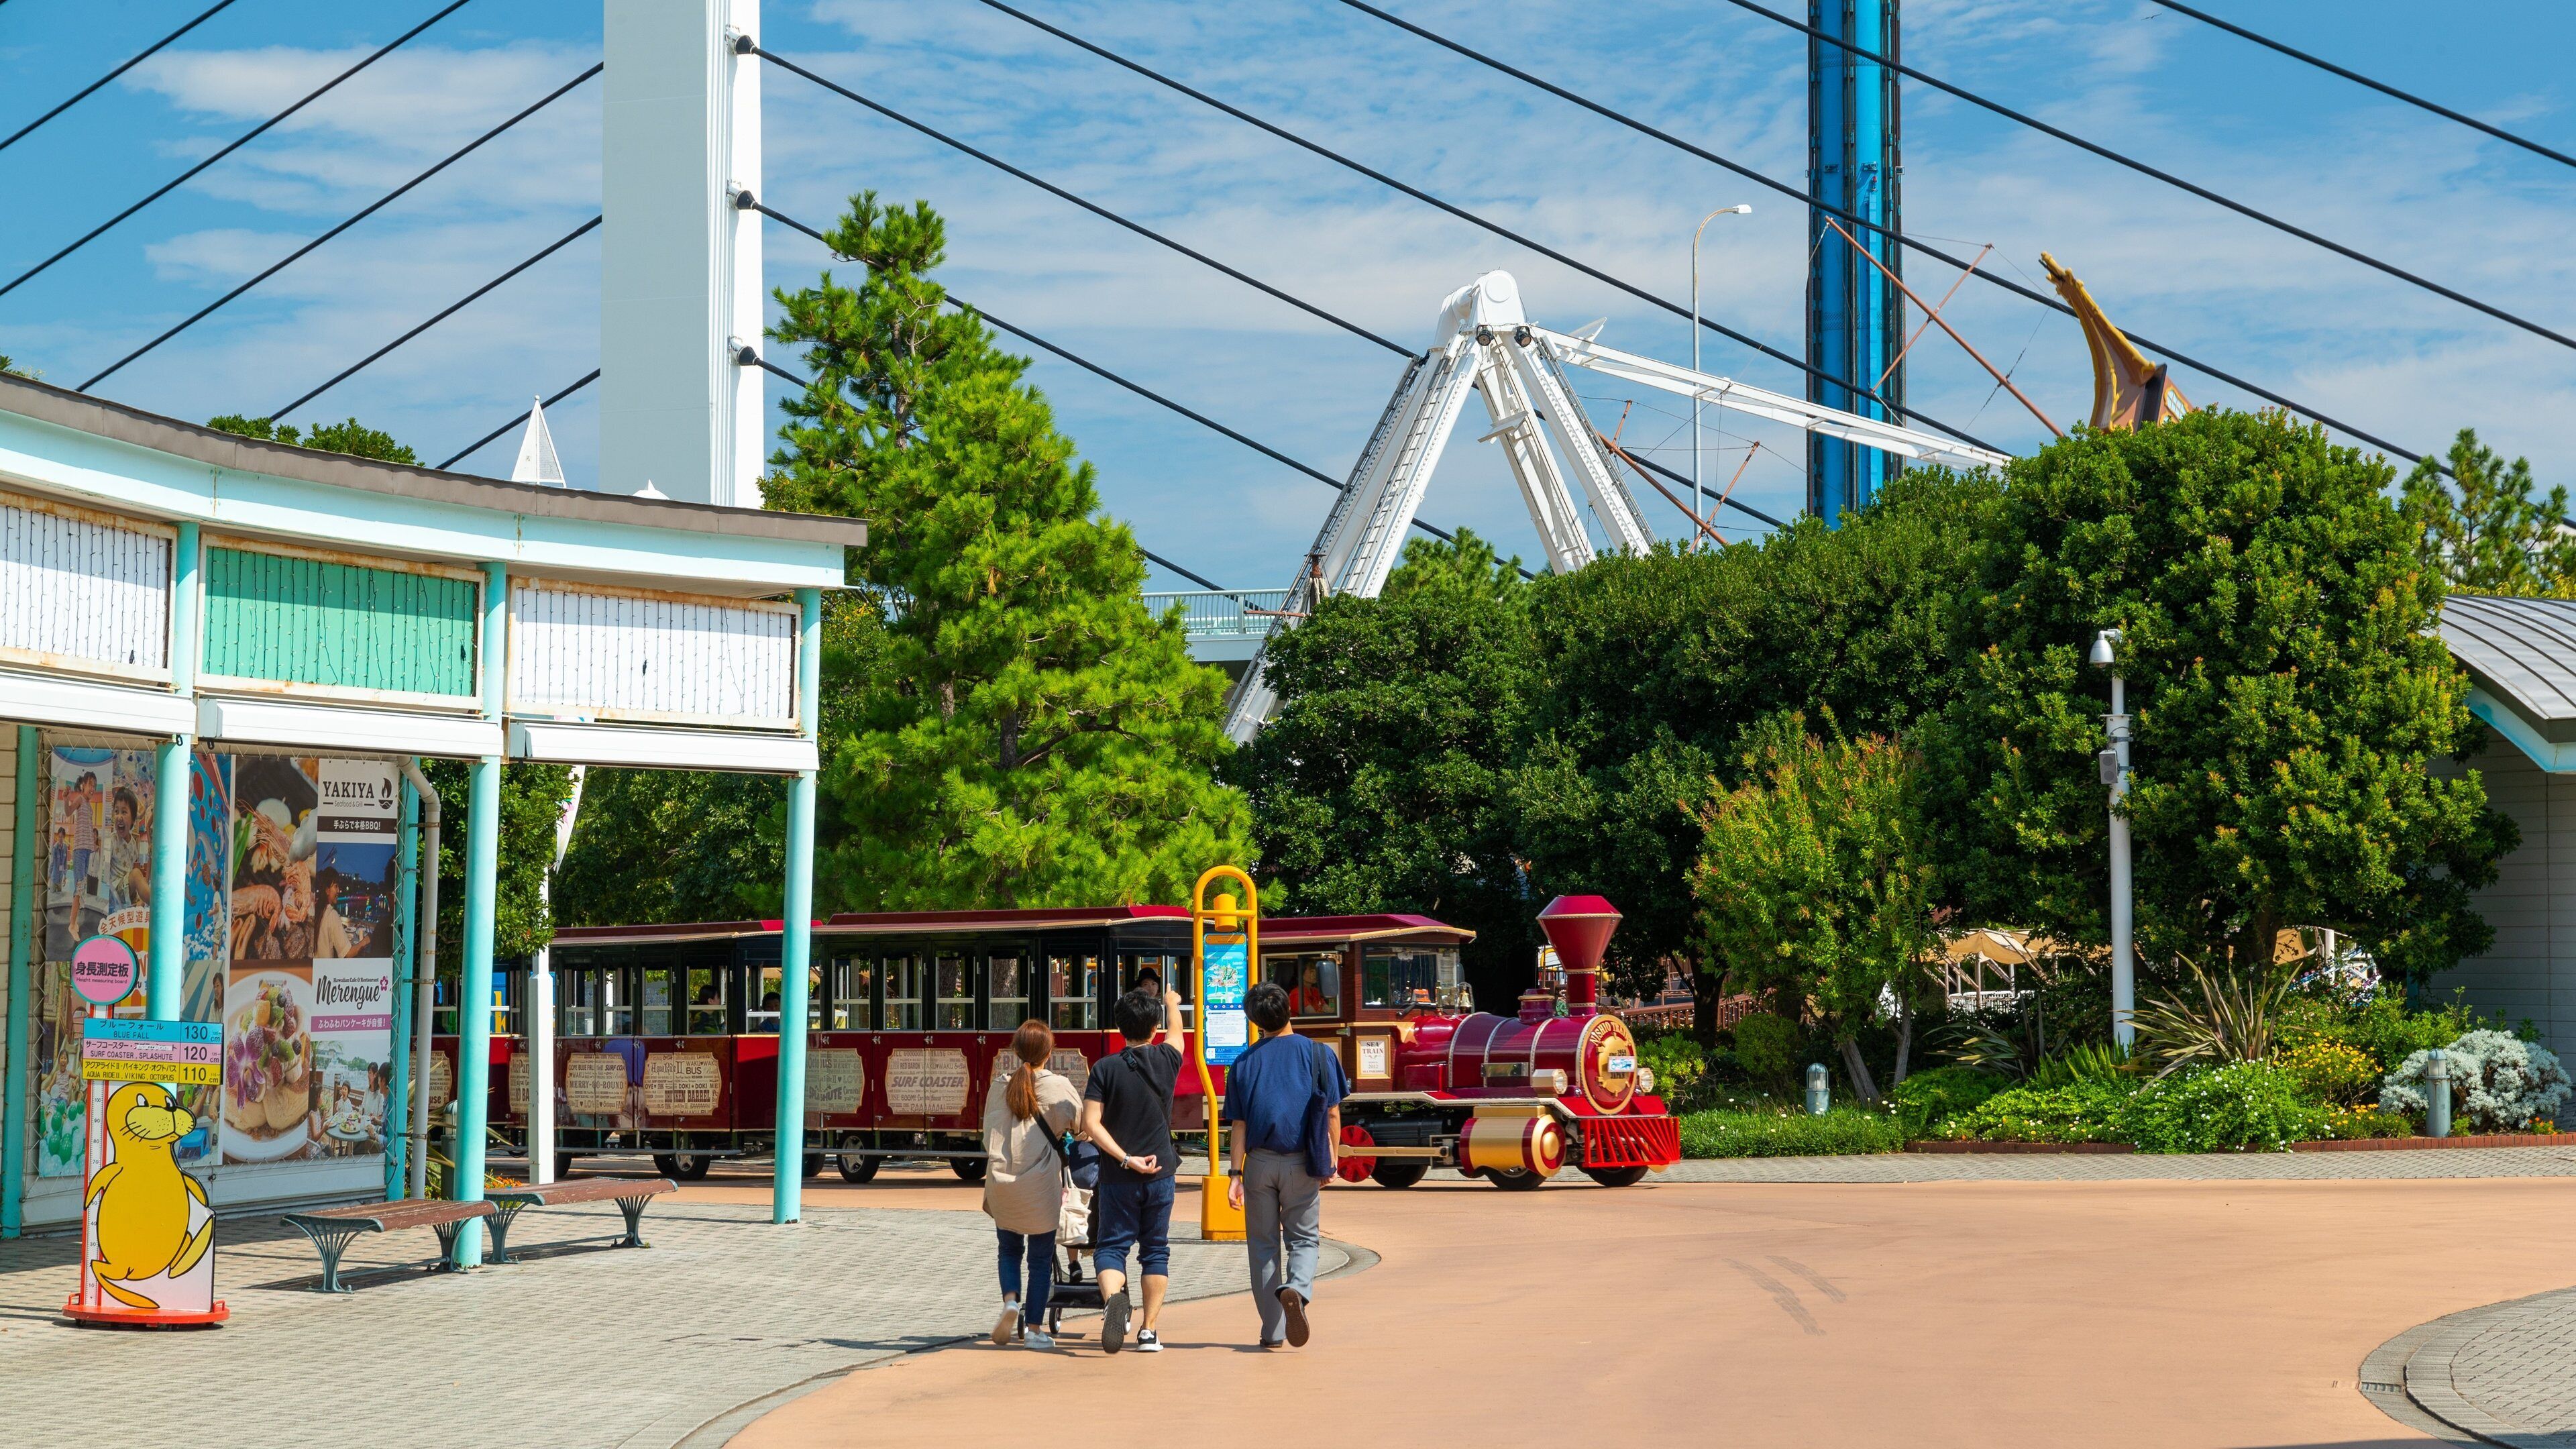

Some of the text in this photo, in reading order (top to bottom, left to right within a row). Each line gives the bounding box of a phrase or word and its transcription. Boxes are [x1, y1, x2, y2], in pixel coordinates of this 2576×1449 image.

[323, 782, 374, 798] YAKIYA
[76, 961, 129, 977] 身長測定板
[317, 975, 381, 1010] Merengue
[113, 1030, 130, 1038] BLUE
[184, 1025, 208, 1040] 130
[184, 1046, 207, 1061] 120
[183, 1067, 207, 1081] 110
[891, 1076, 965, 1087] SURF COASTER
